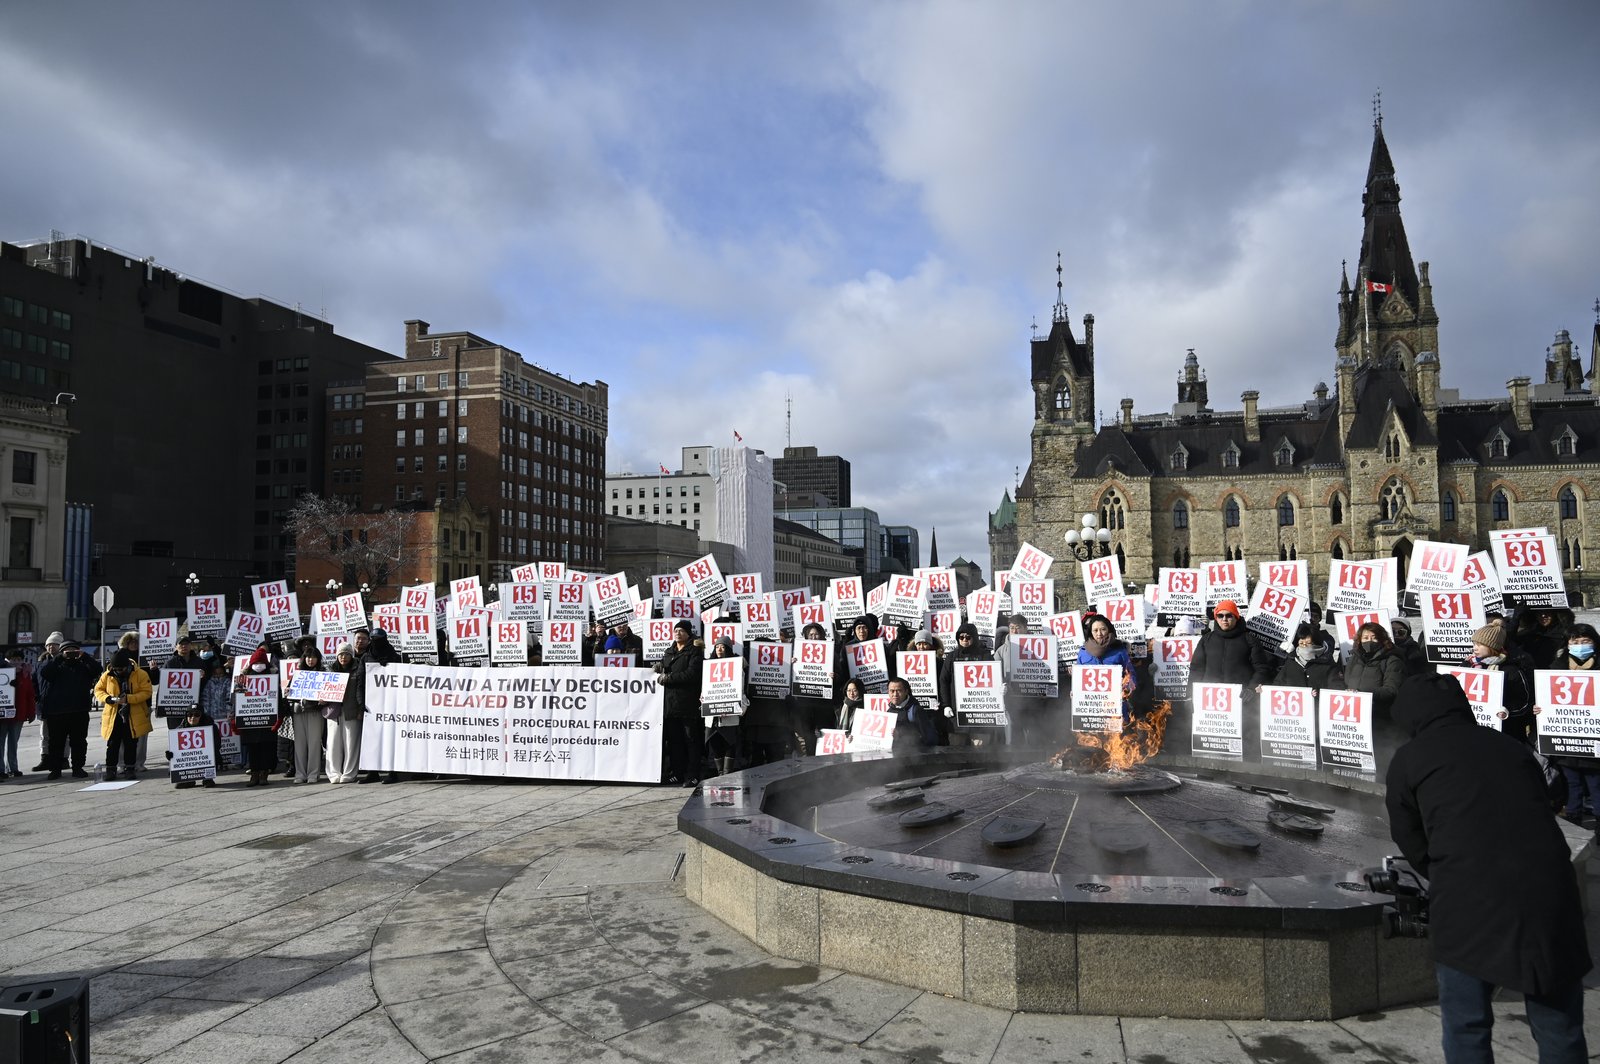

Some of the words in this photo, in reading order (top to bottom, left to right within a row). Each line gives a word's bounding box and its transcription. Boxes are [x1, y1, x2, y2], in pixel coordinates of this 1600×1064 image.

[1022, 551, 1043, 575] 43
[1429, 548, 1452, 572] 70
[1509, 541, 1542, 567] 36
[545, 564, 558, 578] 31
[689, 561, 710, 582] 33
[1092, 561, 1109, 582] 29
[1213, 565, 1230, 584] 11
[1272, 565, 1294, 586] 27
[1343, 565, 1367, 589] 16
[262, 584, 280, 597] 19
[600, 579, 620, 598] 68
[736, 577, 753, 594] 34
[839, 581, 855, 599] 33
[898, 578, 918, 597] 34
[931, 573, 949, 592] 38
[1172, 572, 1194, 592] 63
[408, 591, 426, 608] 42
[516, 586, 534, 603] 15
[562, 585, 580, 602] 53
[785, 592, 802, 609] 27
[1022, 584, 1043, 604] 65
[1264, 588, 1293, 617] 35
[197, 599, 216, 614] 54
[270, 597, 289, 615] 42
[344, 597, 357, 612] 39
[674, 600, 693, 618] 55
[750, 603, 768, 621] 34
[977, 594, 993, 613] 55
[1109, 600, 1131, 621] 72
[1437, 594, 1468, 618] 31
[322, 605, 338, 621] 32
[804, 606, 821, 623] 27
[149, 621, 168, 638] 30
[240, 615, 261, 633] 20
[410, 615, 427, 634] 11
[460, 619, 478, 638] 71
[652, 622, 672, 641] 68
[932, 614, 951, 632] 30
[1053, 617, 1074, 638] 62
[501, 624, 518, 642] 53
[552, 623, 572, 642] 34
[762, 645, 781, 665] 81
[804, 643, 824, 663] 33
[857, 643, 876, 665] 46
[1022, 638, 1045, 660] 40
[1166, 640, 1189, 662] 23
[712, 662, 731, 681] 41
[907, 655, 926, 674] 24
[170, 672, 190, 689] 20
[298, 671, 319, 680] STOP
[322, 673, 340, 682] THE
[374, 674, 398, 688] WE
[402, 675, 477, 691] DEMAND
[481, 679, 492, 691] A
[498, 678, 561, 692] TIMELY
[566, 679, 656, 694] DECISION
[966, 665, 990, 687] 34
[1084, 669, 1109, 691] 35
[248, 678, 268, 696] 40
[1555, 677, 1589, 704] 37
[432, 693, 508, 709] DELAYED
[513, 695, 537, 709] BY
[542, 695, 587, 710] IRCC
[1205, 688, 1228, 711] 18
[1274, 690, 1300, 715] 36
[1333, 695, 1357, 722] 21
[376, 714, 441, 724] REASONABLE
[443, 716, 499, 727] TIMELINES
[1274, 718, 1300, 726] MONTHS
[1547, 717, 1582, 725] WAITING
[1584, 718, 1600, 726] FOR
[1555, 709, 1591, 717] MONTHS
[512, 719, 590, 729] PROCEDURAL
[593, 720, 650, 730] FAIRNESS
[862, 714, 886, 737] 22
[1208, 727, 1237, 735] RESPONSE
[1332, 724, 1357, 732] MONTHS
[1542, 725, 1560, 733] IRCC
[1561, 726, 1600, 735] RESPONS
[181, 730, 203, 749] 36
[401, 730, 431, 739] Délais
[434, 732, 500, 743] raisonnables
[513, 732, 548, 745] Équité
[552, 735, 619, 746] procédurale
[824, 733, 843, 753] 43
[1278, 732, 1310, 741] RESPONSE
[1327, 730, 1351, 739] WAITING
[1352, 733, 1364, 741] FOR
[1337, 739, 1368, 749] RESPONSE
[1562, 738, 1594, 746] TIMELINE
[445, 746, 499, 761] 给出时限
[514, 749, 571, 764] 程序公平
